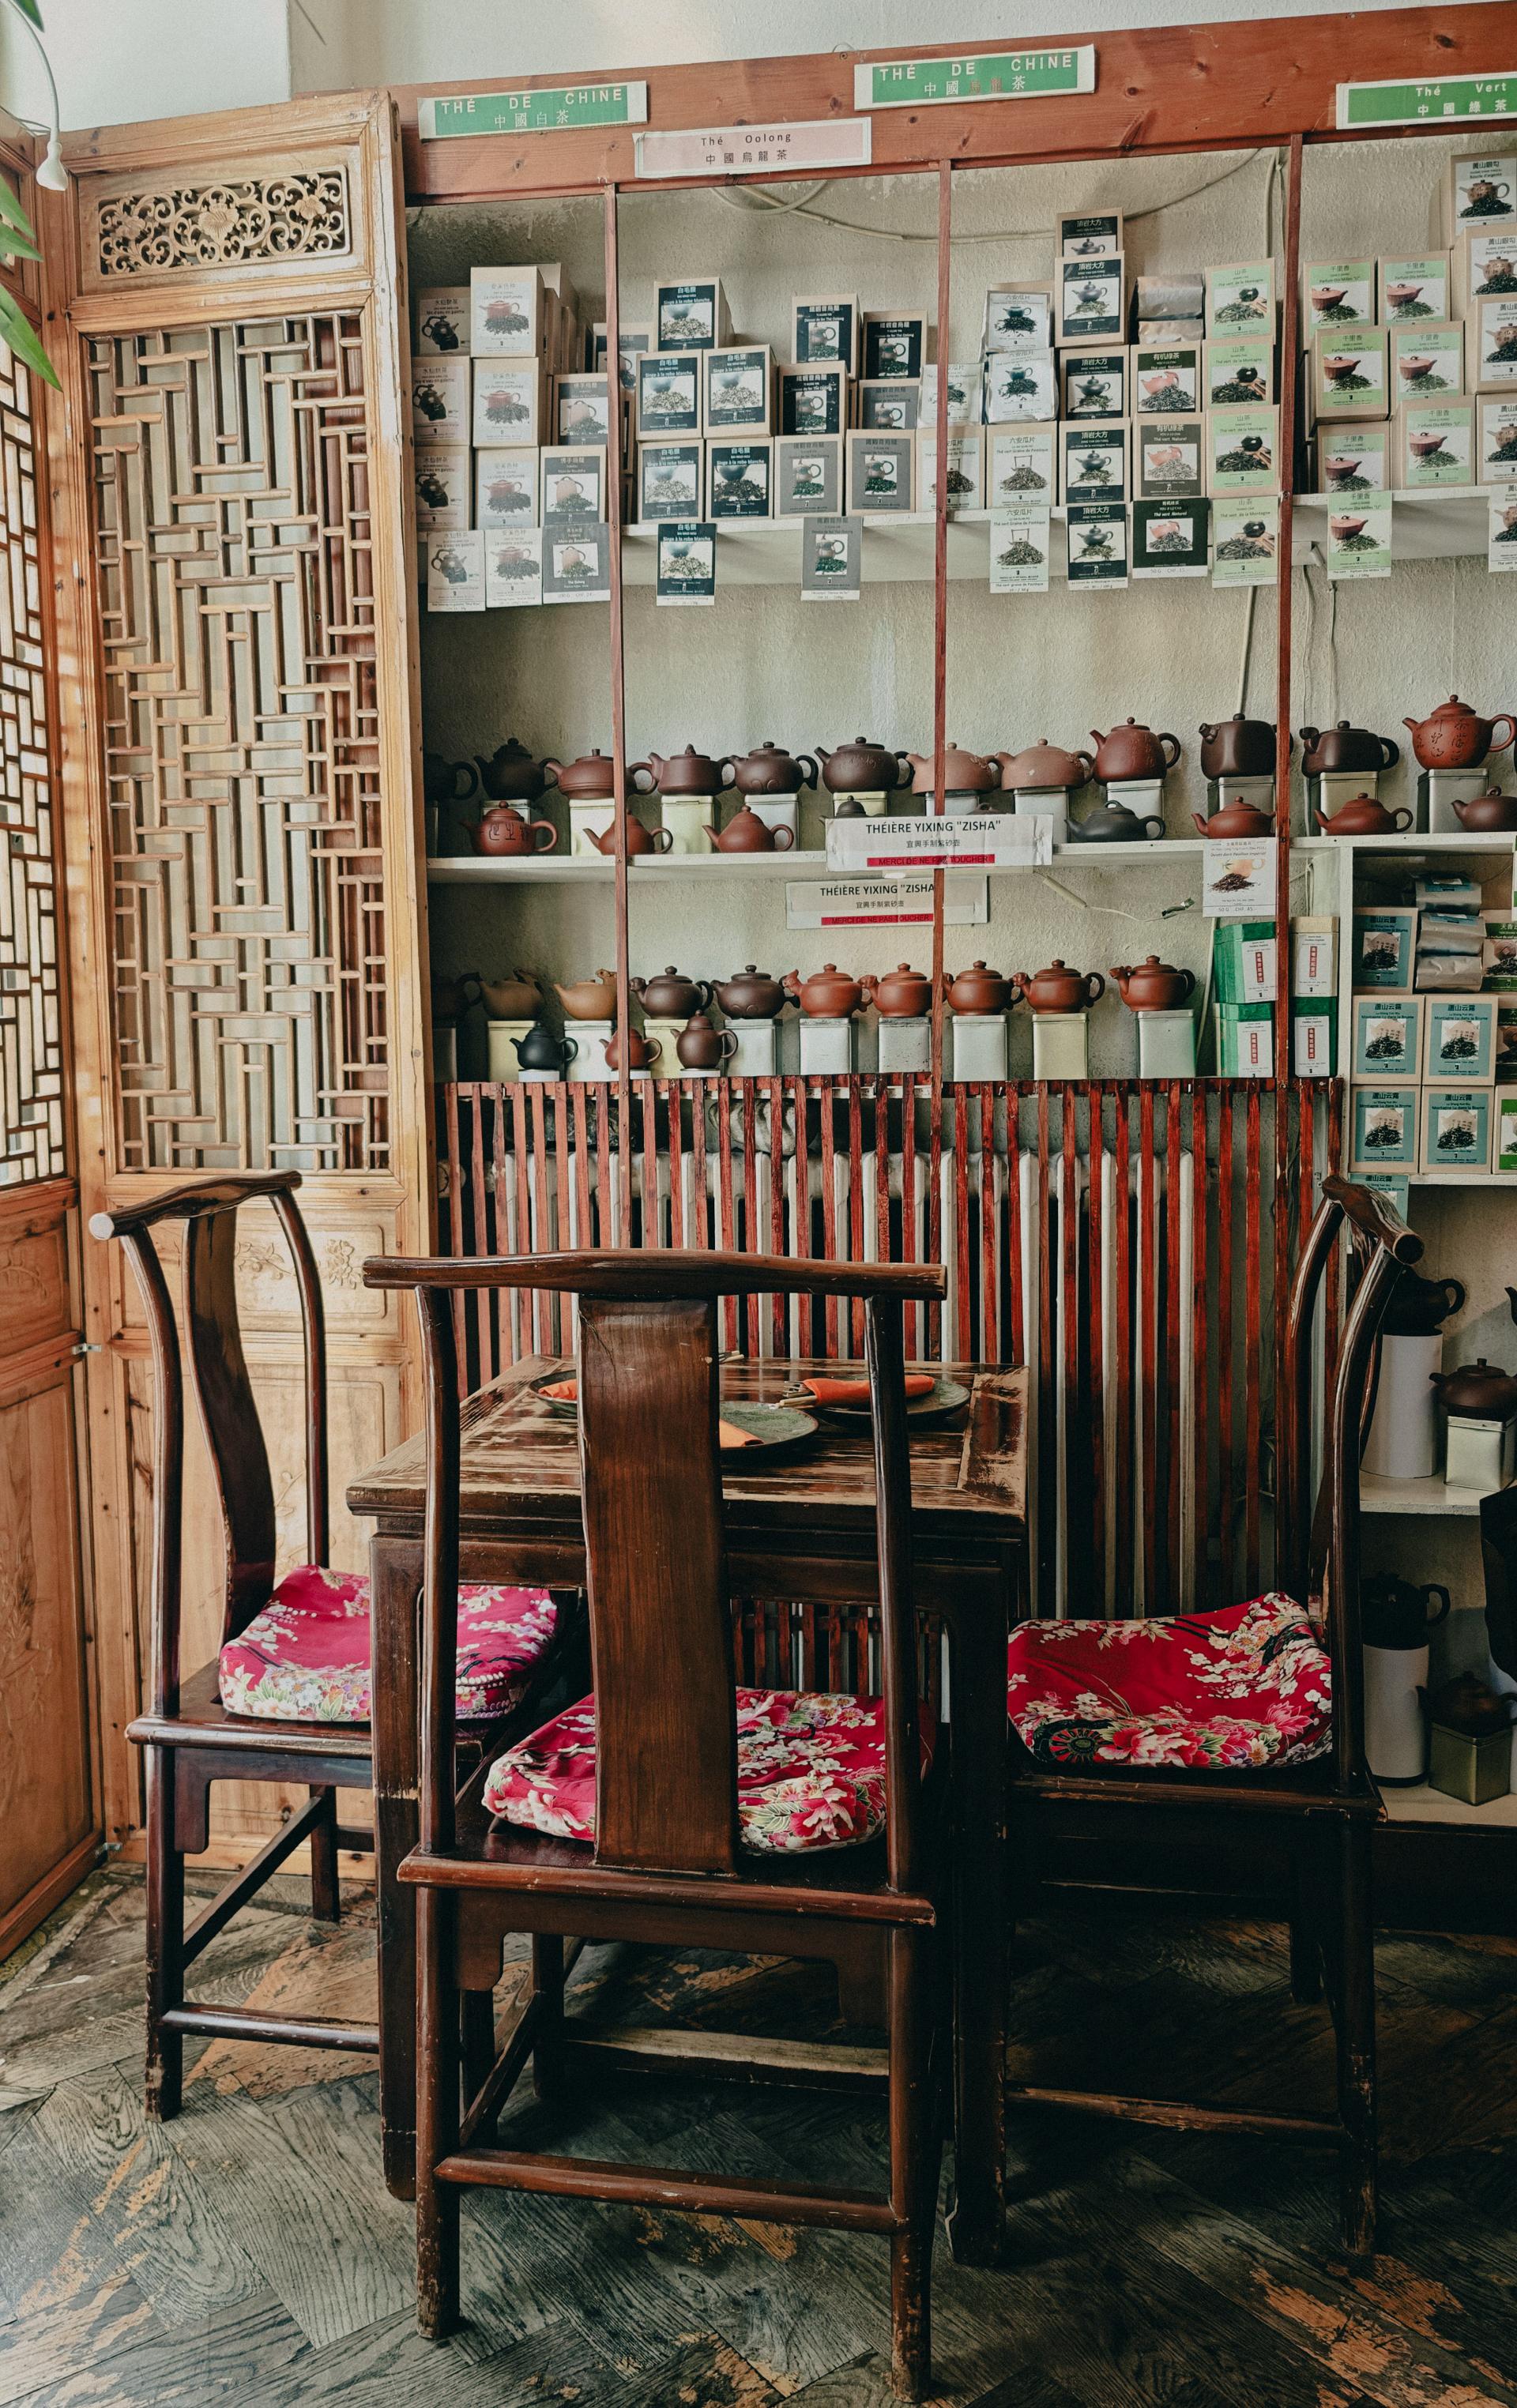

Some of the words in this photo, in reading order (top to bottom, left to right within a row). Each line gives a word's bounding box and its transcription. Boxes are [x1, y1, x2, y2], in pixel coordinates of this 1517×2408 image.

[879, 65, 916, 81] THÉ
[952, 62, 975, 77] DE
[1011, 54, 1071, 71] CHINE
[1416, 86, 1441, 96] Thé
[1475, 83, 1507, 93] Vert
[441, 98, 476, 115] THÉ
[509, 96, 531, 109] DE
[565, 88, 622, 104] CHINE
[495, 109, 569, 129] 中國白茶
[701, 137, 723, 146] Thé
[745, 134, 792, 144] Oolong
[866, 822, 911, 833] THÉIÈRE
[914, 822, 953, 833] YIXING
[957, 820, 1001, 831] "ZISHA"
[879, 857, 905, 866] MERCI
[906, 856, 917, 865] DE
[950, 855, 988, 863] TOUCHER
[820, 885, 860, 896] THÉIÈRE
[864, 884, 898, 895] YIXING
[901, 884, 934, 894] "ZISHA
